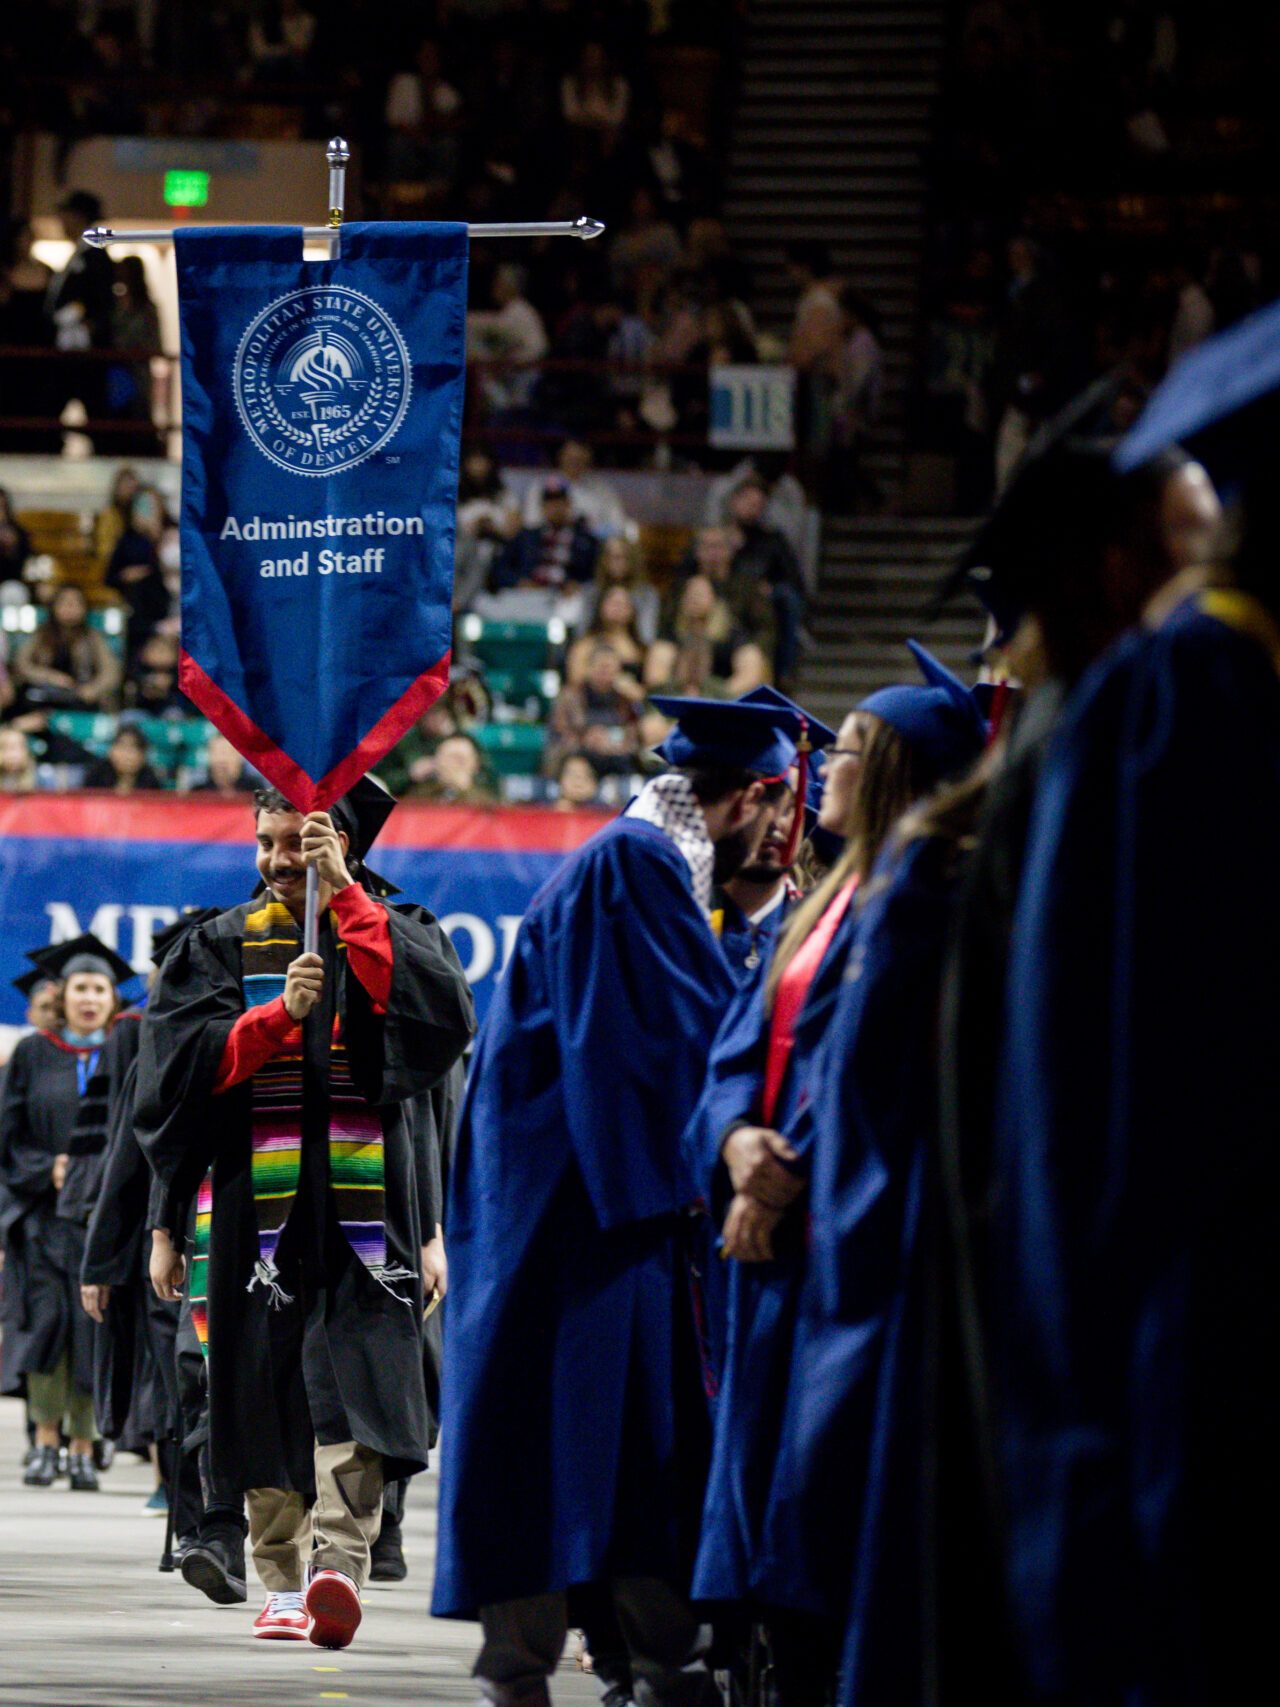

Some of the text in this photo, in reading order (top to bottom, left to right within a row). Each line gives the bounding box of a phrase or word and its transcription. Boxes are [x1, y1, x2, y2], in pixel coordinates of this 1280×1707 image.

[243, 296, 401, 434] METROPOLITAN STATE UNIVERSITY
[260, 330, 288, 377] EXCELLENCE
[288, 322, 299, 332] IN
[320, 405, 352, 420] 1965
[272, 434, 372, 466] OF DENVER
[219, 511, 424, 541] Adminstration
[259, 548, 385, 577] and Staff
